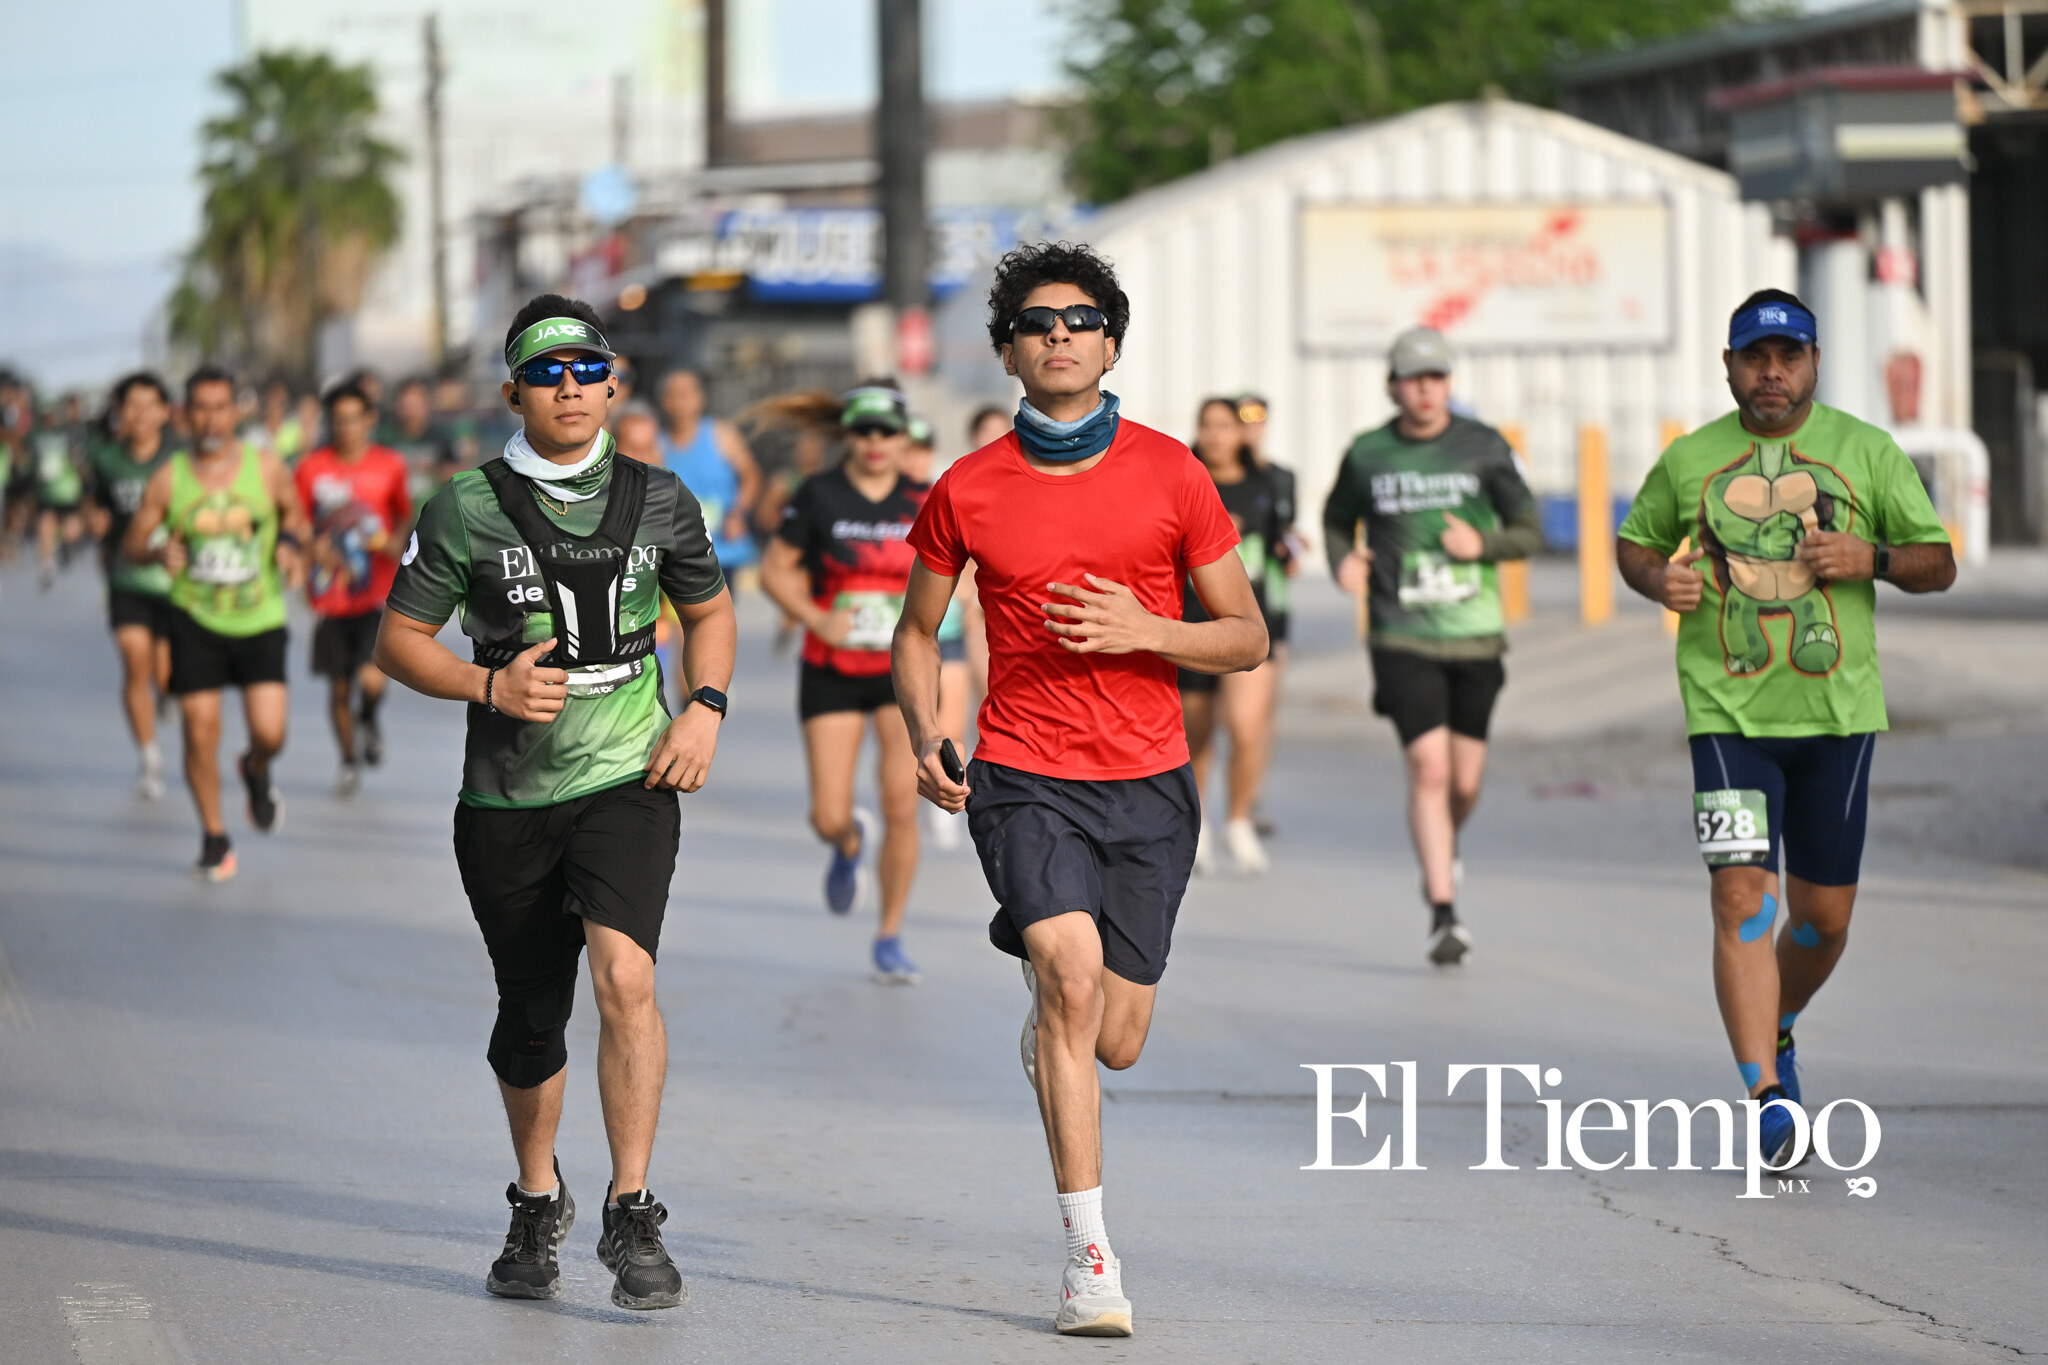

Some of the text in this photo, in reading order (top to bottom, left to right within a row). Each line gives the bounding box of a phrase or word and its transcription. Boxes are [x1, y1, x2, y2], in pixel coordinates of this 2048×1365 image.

[498, 545, 538, 580] El
[506, 584, 544, 604] de
[1697, 808, 1757, 842] 528
